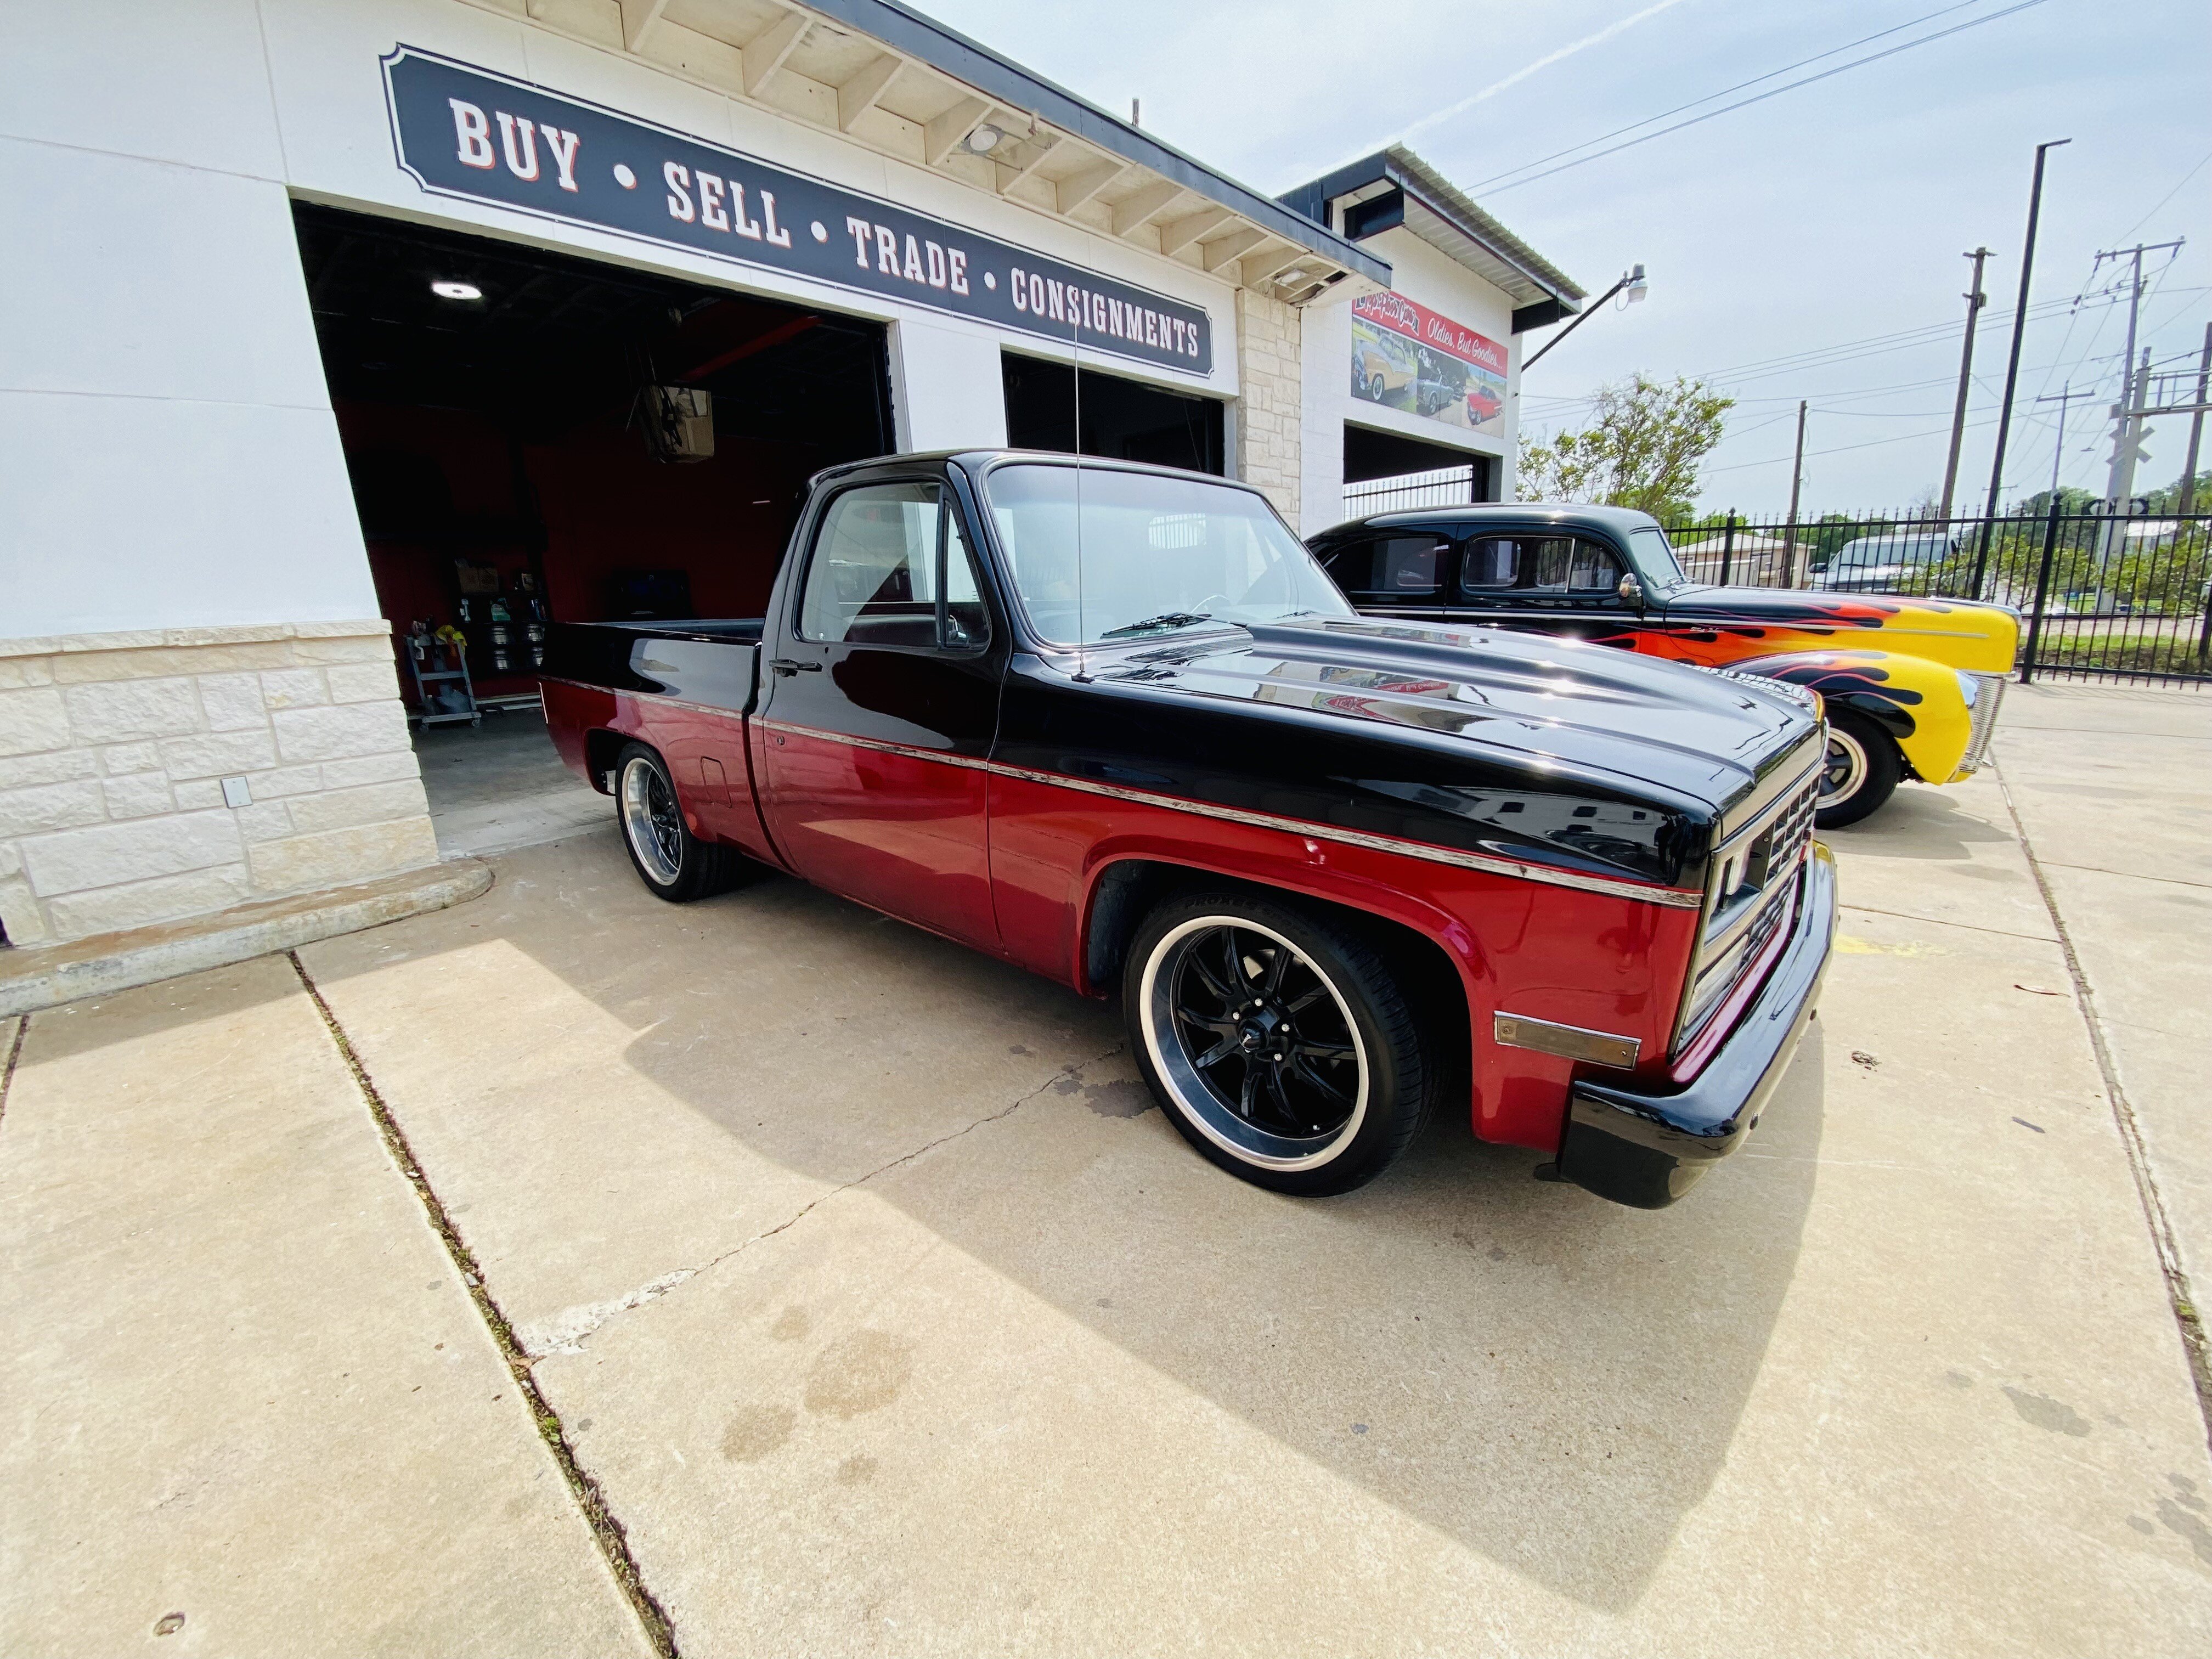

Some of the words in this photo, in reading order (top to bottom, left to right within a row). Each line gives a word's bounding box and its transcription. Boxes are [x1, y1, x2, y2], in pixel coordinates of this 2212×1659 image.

[448, 99, 580, 192] BUY
[664, 161, 792, 249] SELL
[846, 216, 969, 296] TRADE
[1011, 267, 1199, 358] CONSIGNMENTS
[1427, 318, 1455, 349] Oldies,
[1457, 331, 1471, 355] But
